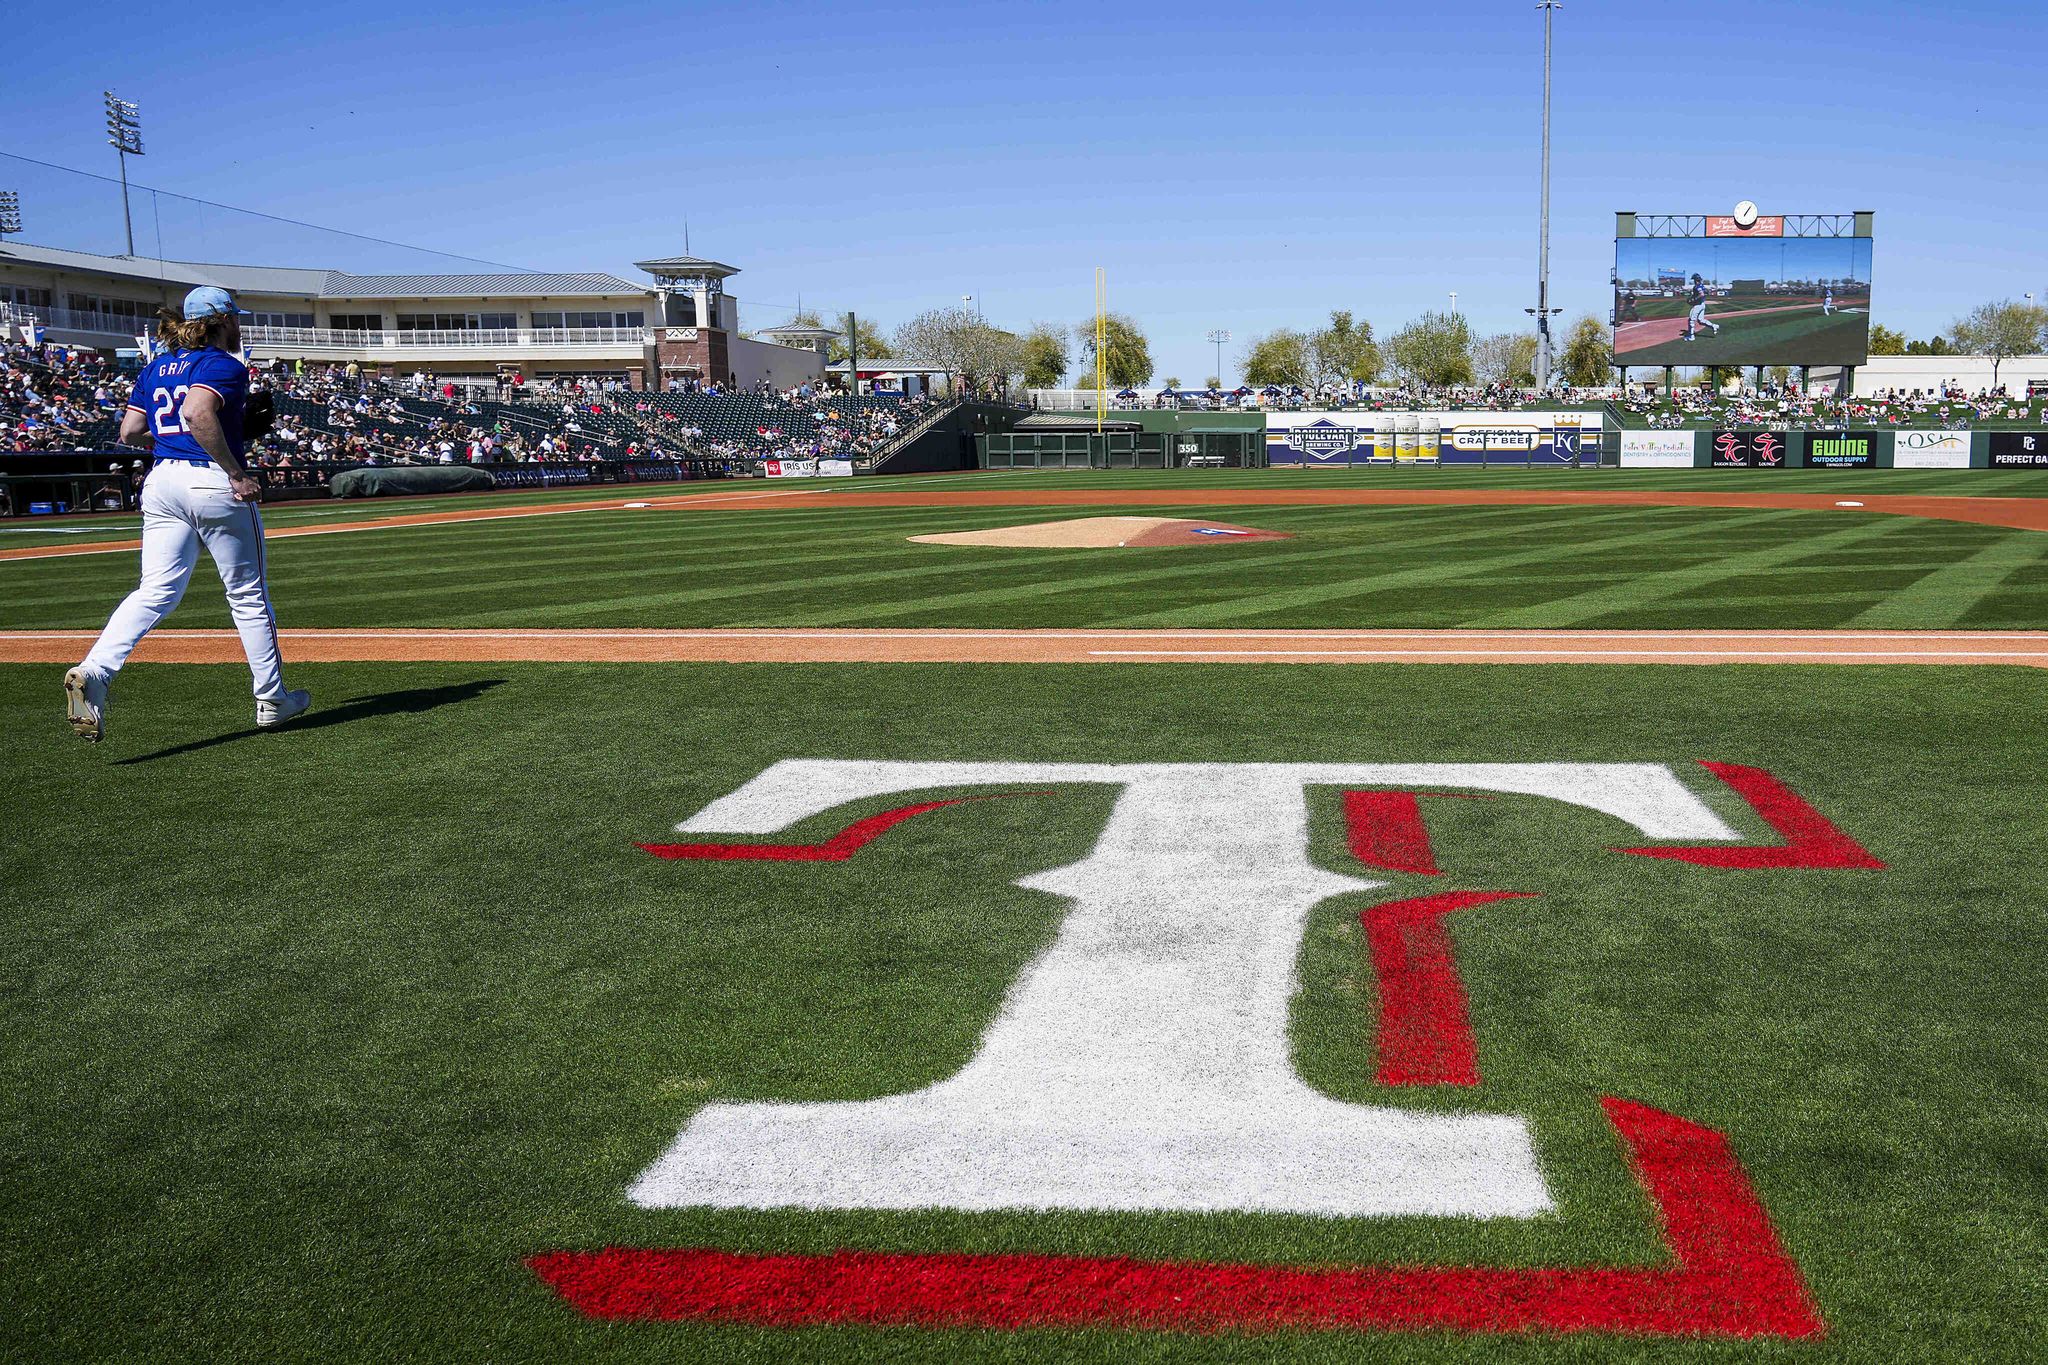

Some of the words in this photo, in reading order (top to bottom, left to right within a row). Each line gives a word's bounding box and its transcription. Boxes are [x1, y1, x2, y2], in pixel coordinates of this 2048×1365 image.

[1770, 422, 1788, 431] 379
[1294, 429, 1352, 445] BOULEVARD
[1469, 429, 1524, 437] OFFICIAL
[1180, 444, 1197, 453] 350
[1995, 455, 2034, 464] PERFECT
